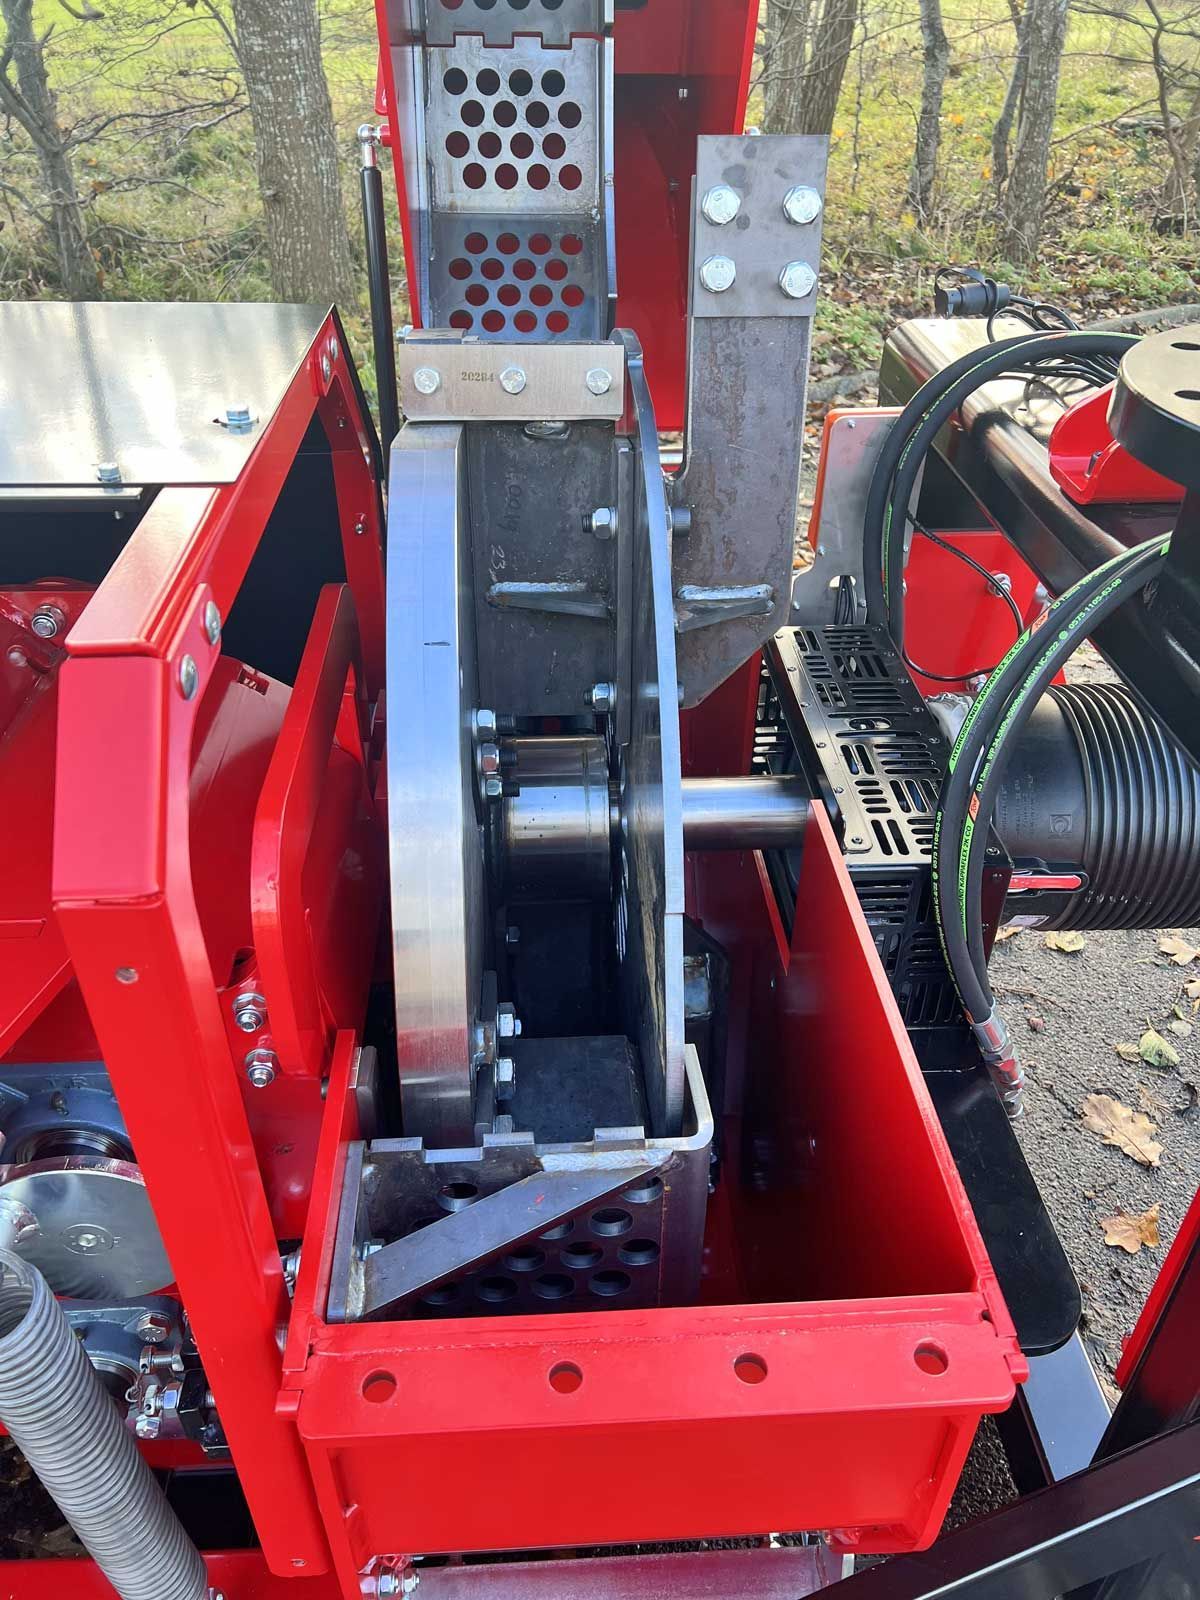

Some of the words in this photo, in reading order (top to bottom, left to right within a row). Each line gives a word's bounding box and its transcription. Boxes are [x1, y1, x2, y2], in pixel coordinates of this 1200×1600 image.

[1067, 610, 1086, 630] 0575
[951, 705, 979, 761] HYDROSCAND
[978, 661, 1007, 705] KAPPAFLEX
[1005, 650, 1016, 662] 2K
